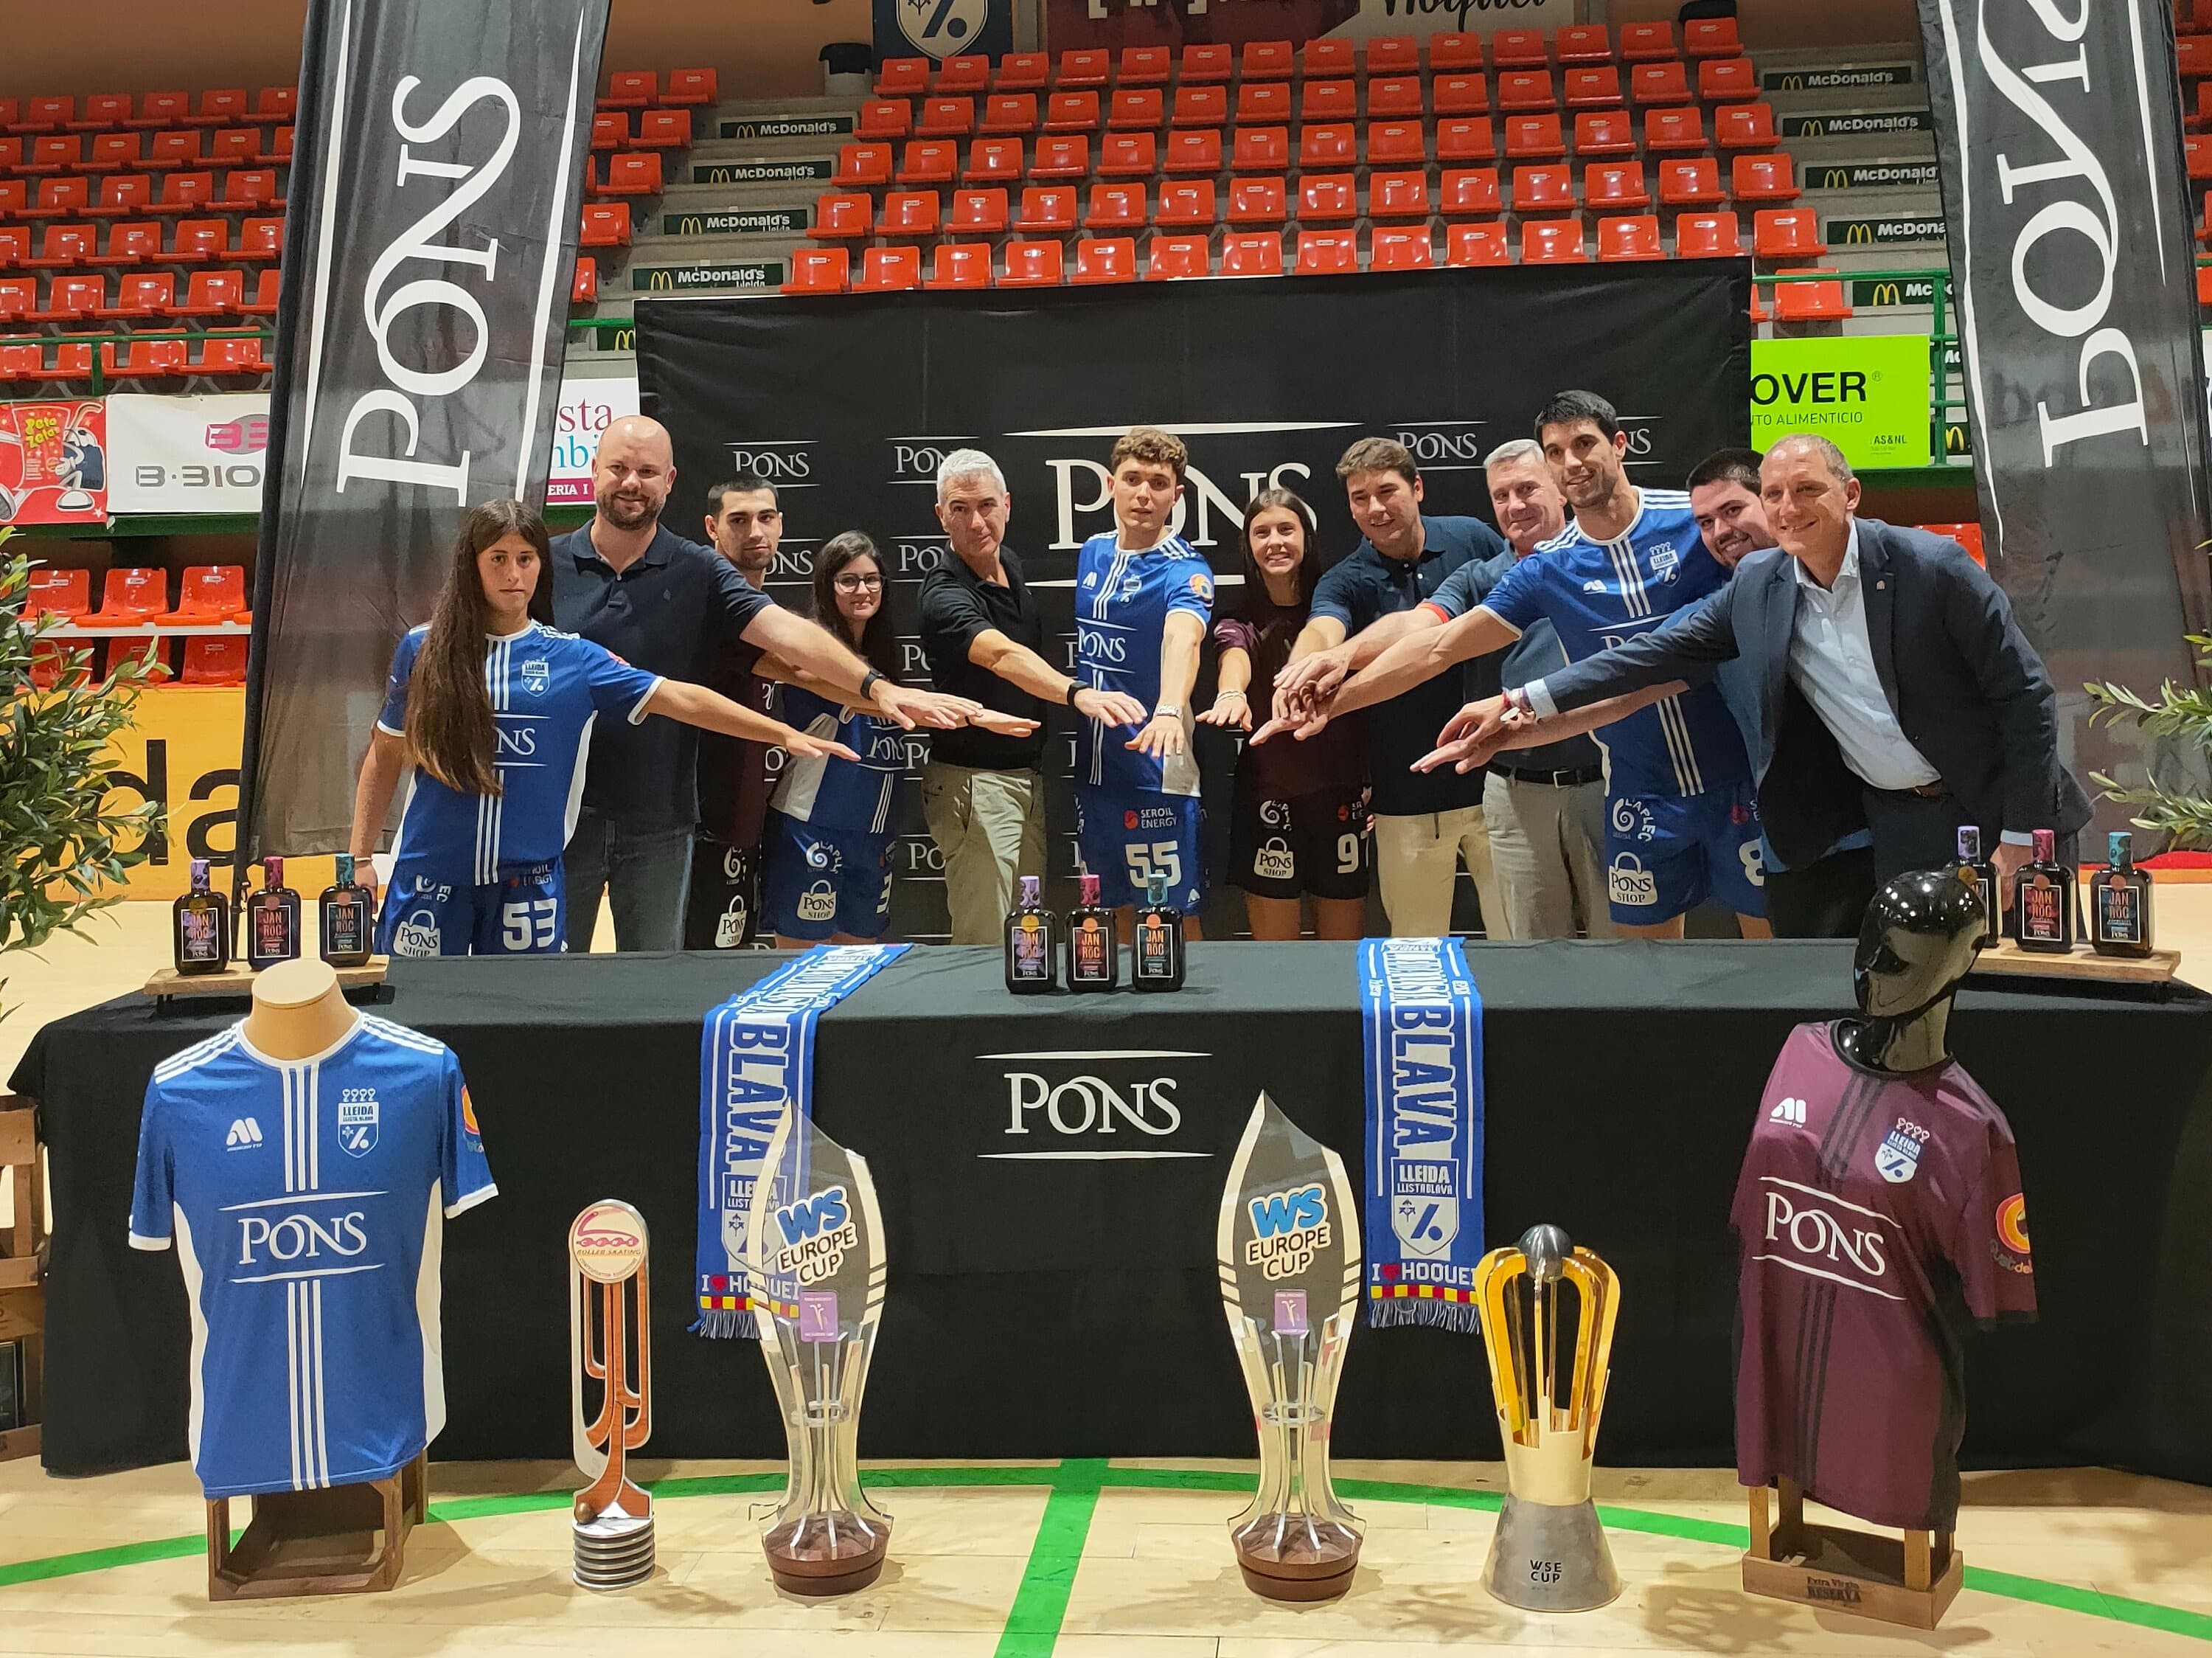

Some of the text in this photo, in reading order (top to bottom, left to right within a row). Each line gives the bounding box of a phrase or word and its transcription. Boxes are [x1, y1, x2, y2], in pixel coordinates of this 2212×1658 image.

[1809, 72, 1893, 86] McDonald's
[760, 121, 836, 134] McDonald's
[1829, 116, 1919, 131] McDonald's
[736, 166, 814, 179] McDonald's
[707, 214, 790, 229] McDonald's
[678, 268, 765, 283] McDonald's
[336, 75, 520, 507] PONS
[1776, 411, 1863, 425] ALIMENTICIO
[1396, 431, 1478, 459] PONS
[733, 451, 810, 478] PONS
[1045, 459, 1318, 549] PNS
[1141, 808, 1174, 818] SEROIL
[1141, 816, 1178, 828] ENERGY
[1125, 840, 1182, 888] 55
[1259, 853, 1292, 869] PONS
[1263, 867, 1287, 876] SHOP
[1611, 872, 1651, 892] PONS
[803, 897, 835, 911] PONS
[1616, 892, 1645, 903] SHOP
[503, 898, 558, 951] 53
[400, 926, 439, 948] PONS
[1082, 933, 1099, 946] JAN
[1146, 930, 1164, 943] JAN
[1392, 1003, 1455, 1148] BLAVA
[1004, 1072, 1181, 1136] PONS
[1399, 1164, 1450, 1184] LLEIDA
[777, 1189, 846, 1246] WS
[1252, 1187, 1324, 1238] WS
[238, 1211, 367, 1265] PONS
[1249, 1227, 1328, 1262] EUROPE
[1764, 1192, 1886, 1277] PONS
[779, 1226, 854, 1270] EUROPE
[799, 1254, 840, 1283] CUP
[1267, 1252, 1311, 1277] CUP
[728, 1274, 800, 1301] HOUEI
[1529, 1559, 1562, 1572] WSE
[1530, 1571, 1561, 1584] CUP
